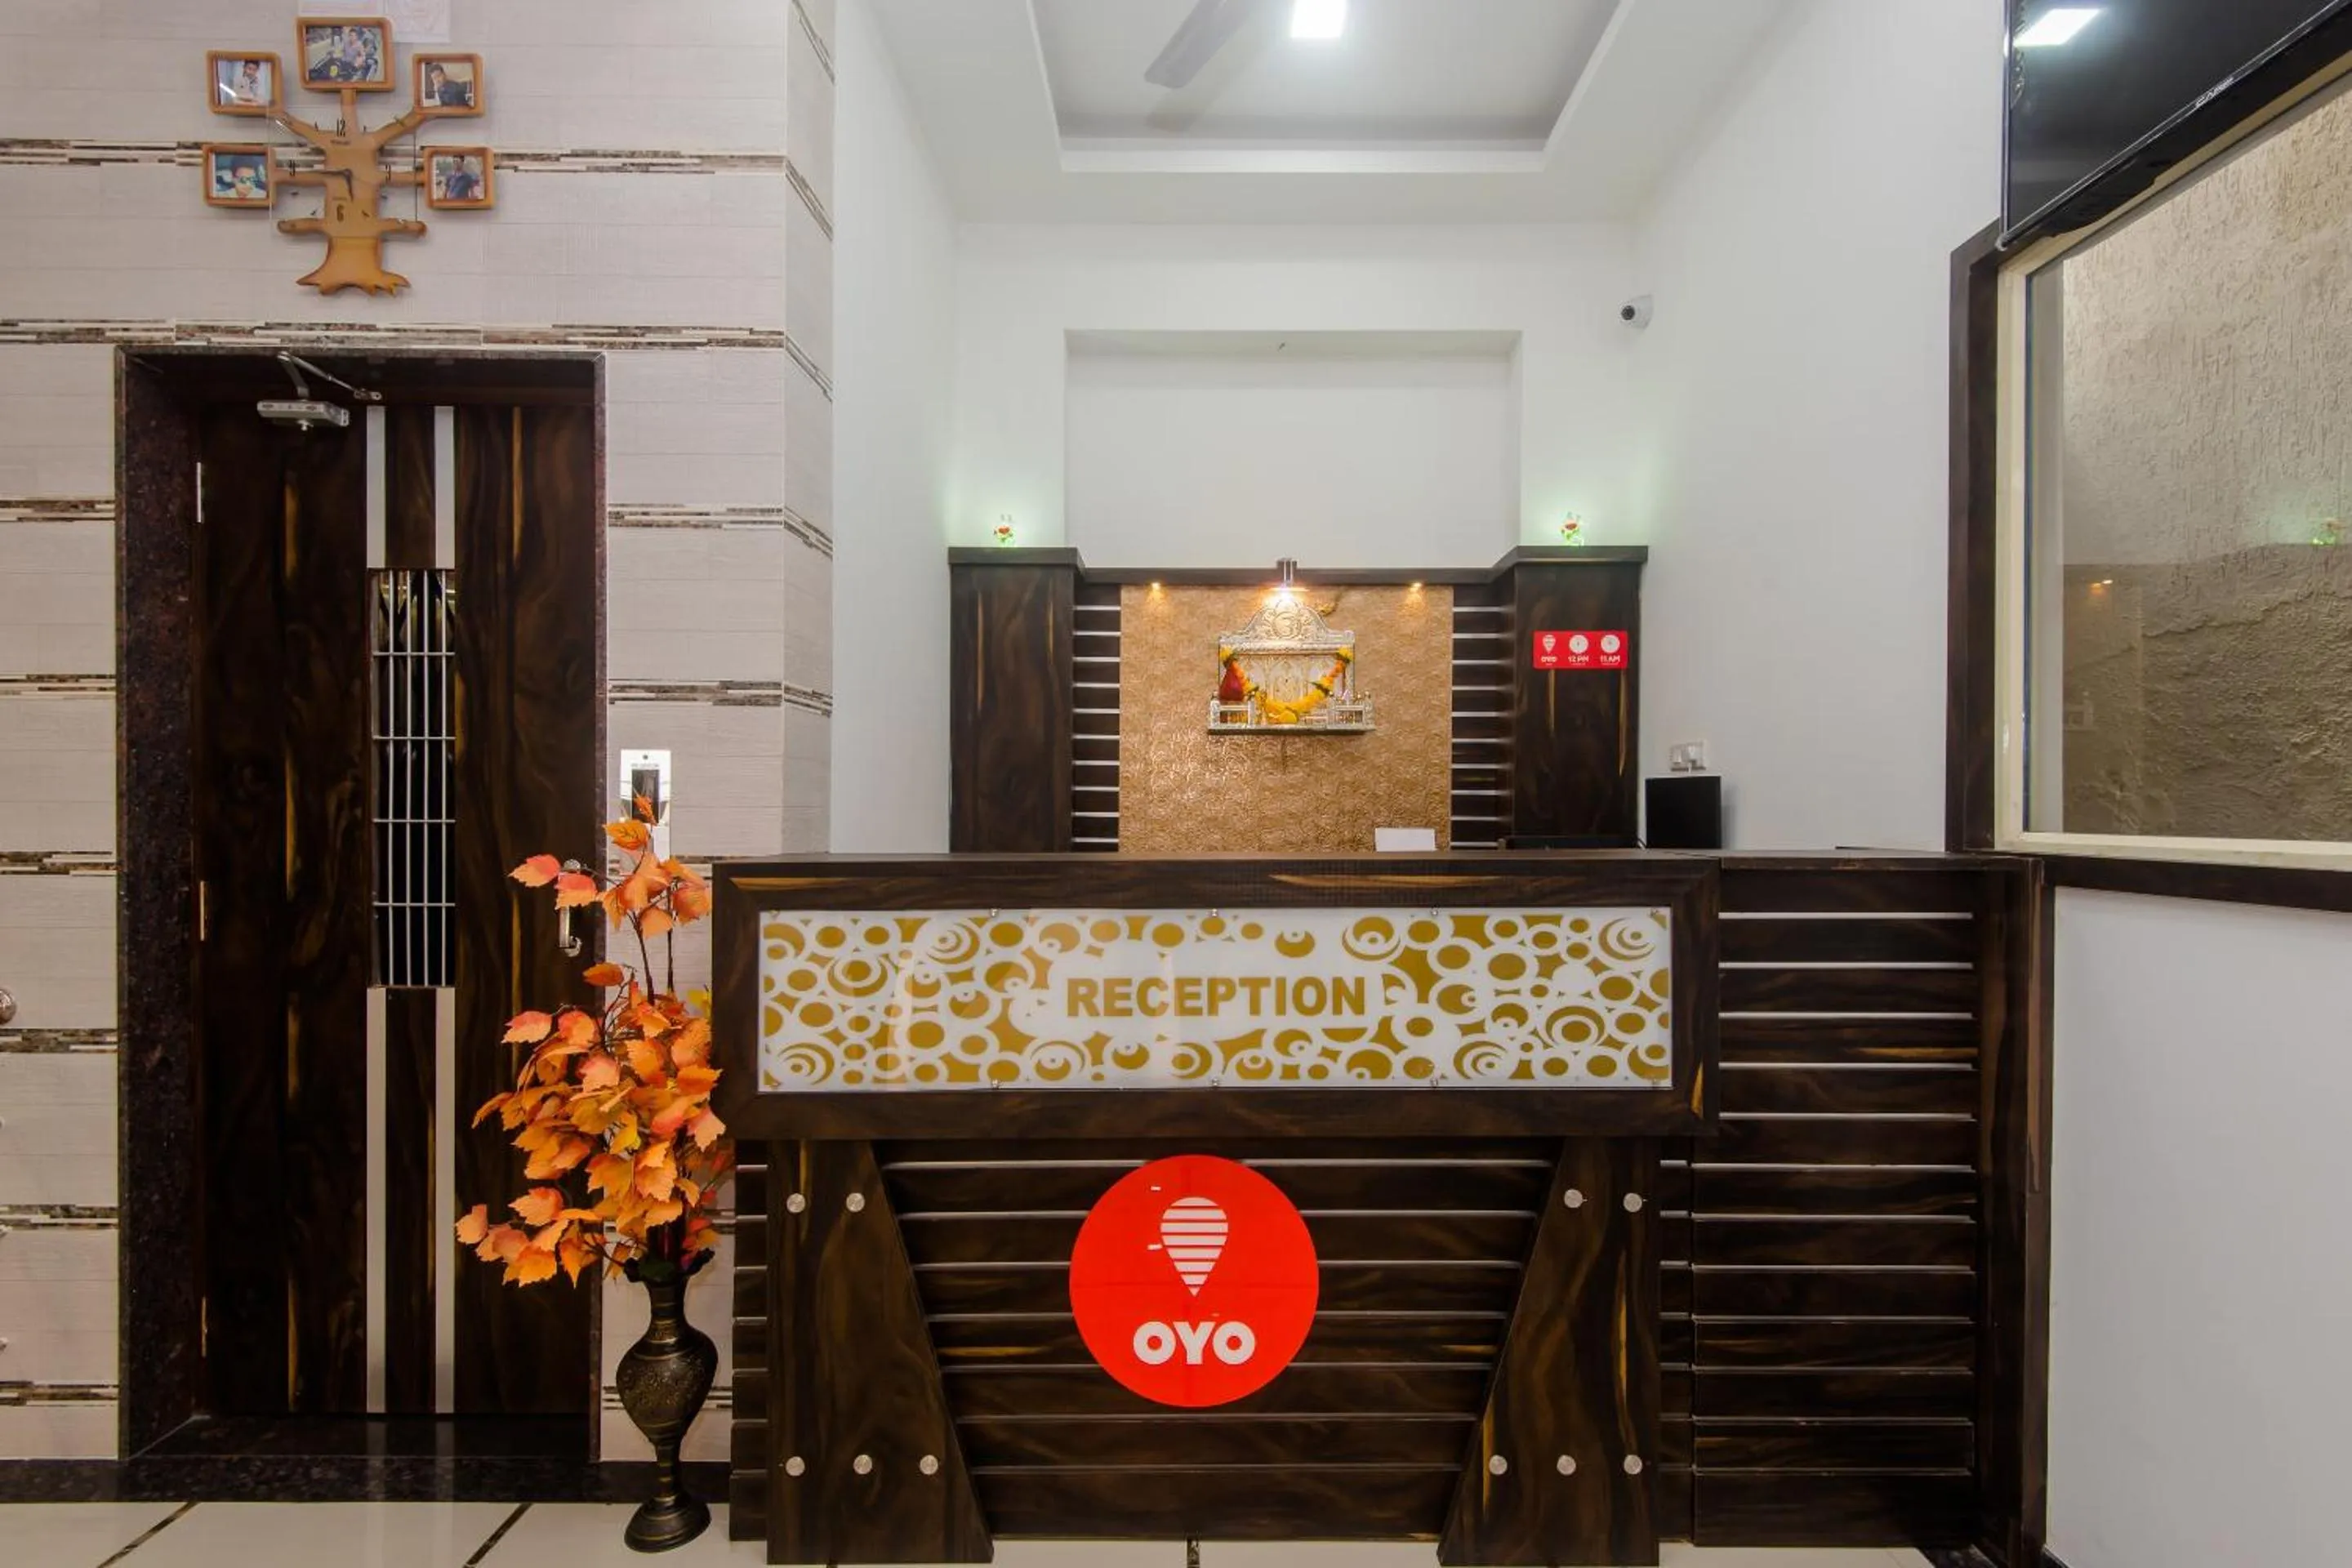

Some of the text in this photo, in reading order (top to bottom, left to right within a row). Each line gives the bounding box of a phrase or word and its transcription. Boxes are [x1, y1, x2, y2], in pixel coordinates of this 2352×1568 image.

[336, 118, 345, 137] 12
[1067, 976, 1365, 1018] RECEPTION
[1133, 1321, 1256, 1365] OYO
